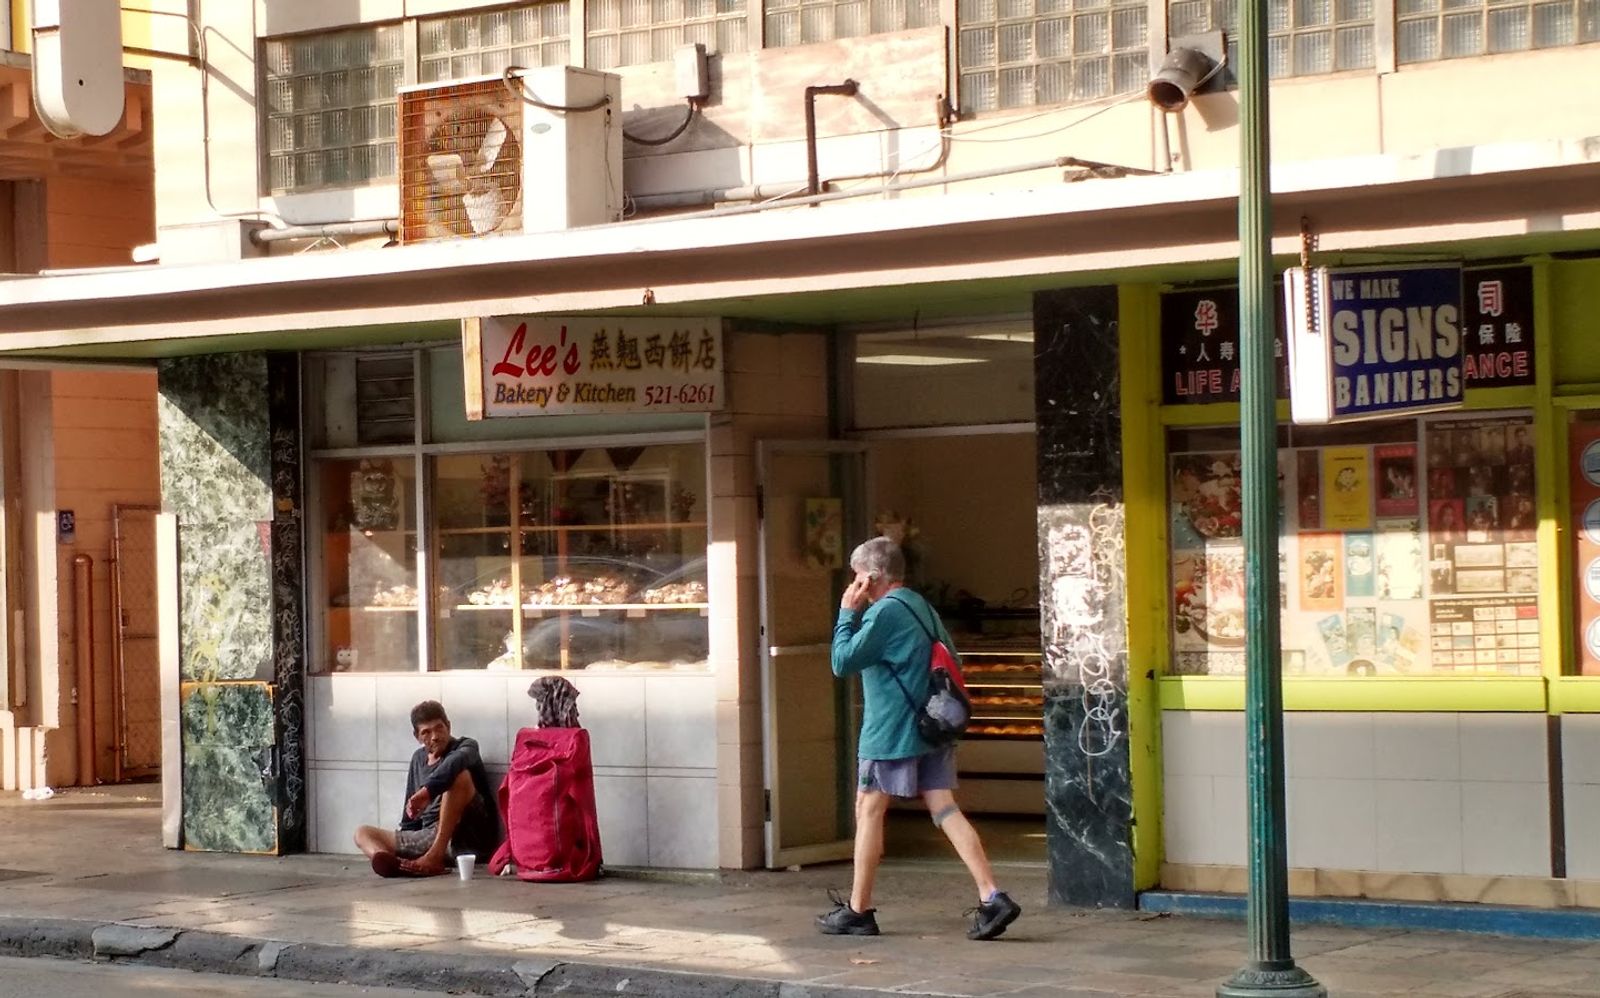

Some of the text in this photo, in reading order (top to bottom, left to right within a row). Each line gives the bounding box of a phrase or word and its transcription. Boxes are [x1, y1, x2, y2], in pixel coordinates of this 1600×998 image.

[1332, 278, 1400, 300] WE MAKE
[492, 321, 581, 378] Lee's
[1333, 304, 1459, 367] SIGNS
[1175, 369, 1222, 395] LIFE
[1463, 351, 1529, 379] ANCE
[1336, 367, 1460, 408] BANNERS
[493, 382, 715, 408] Bakery & Kitchen 521-6261
